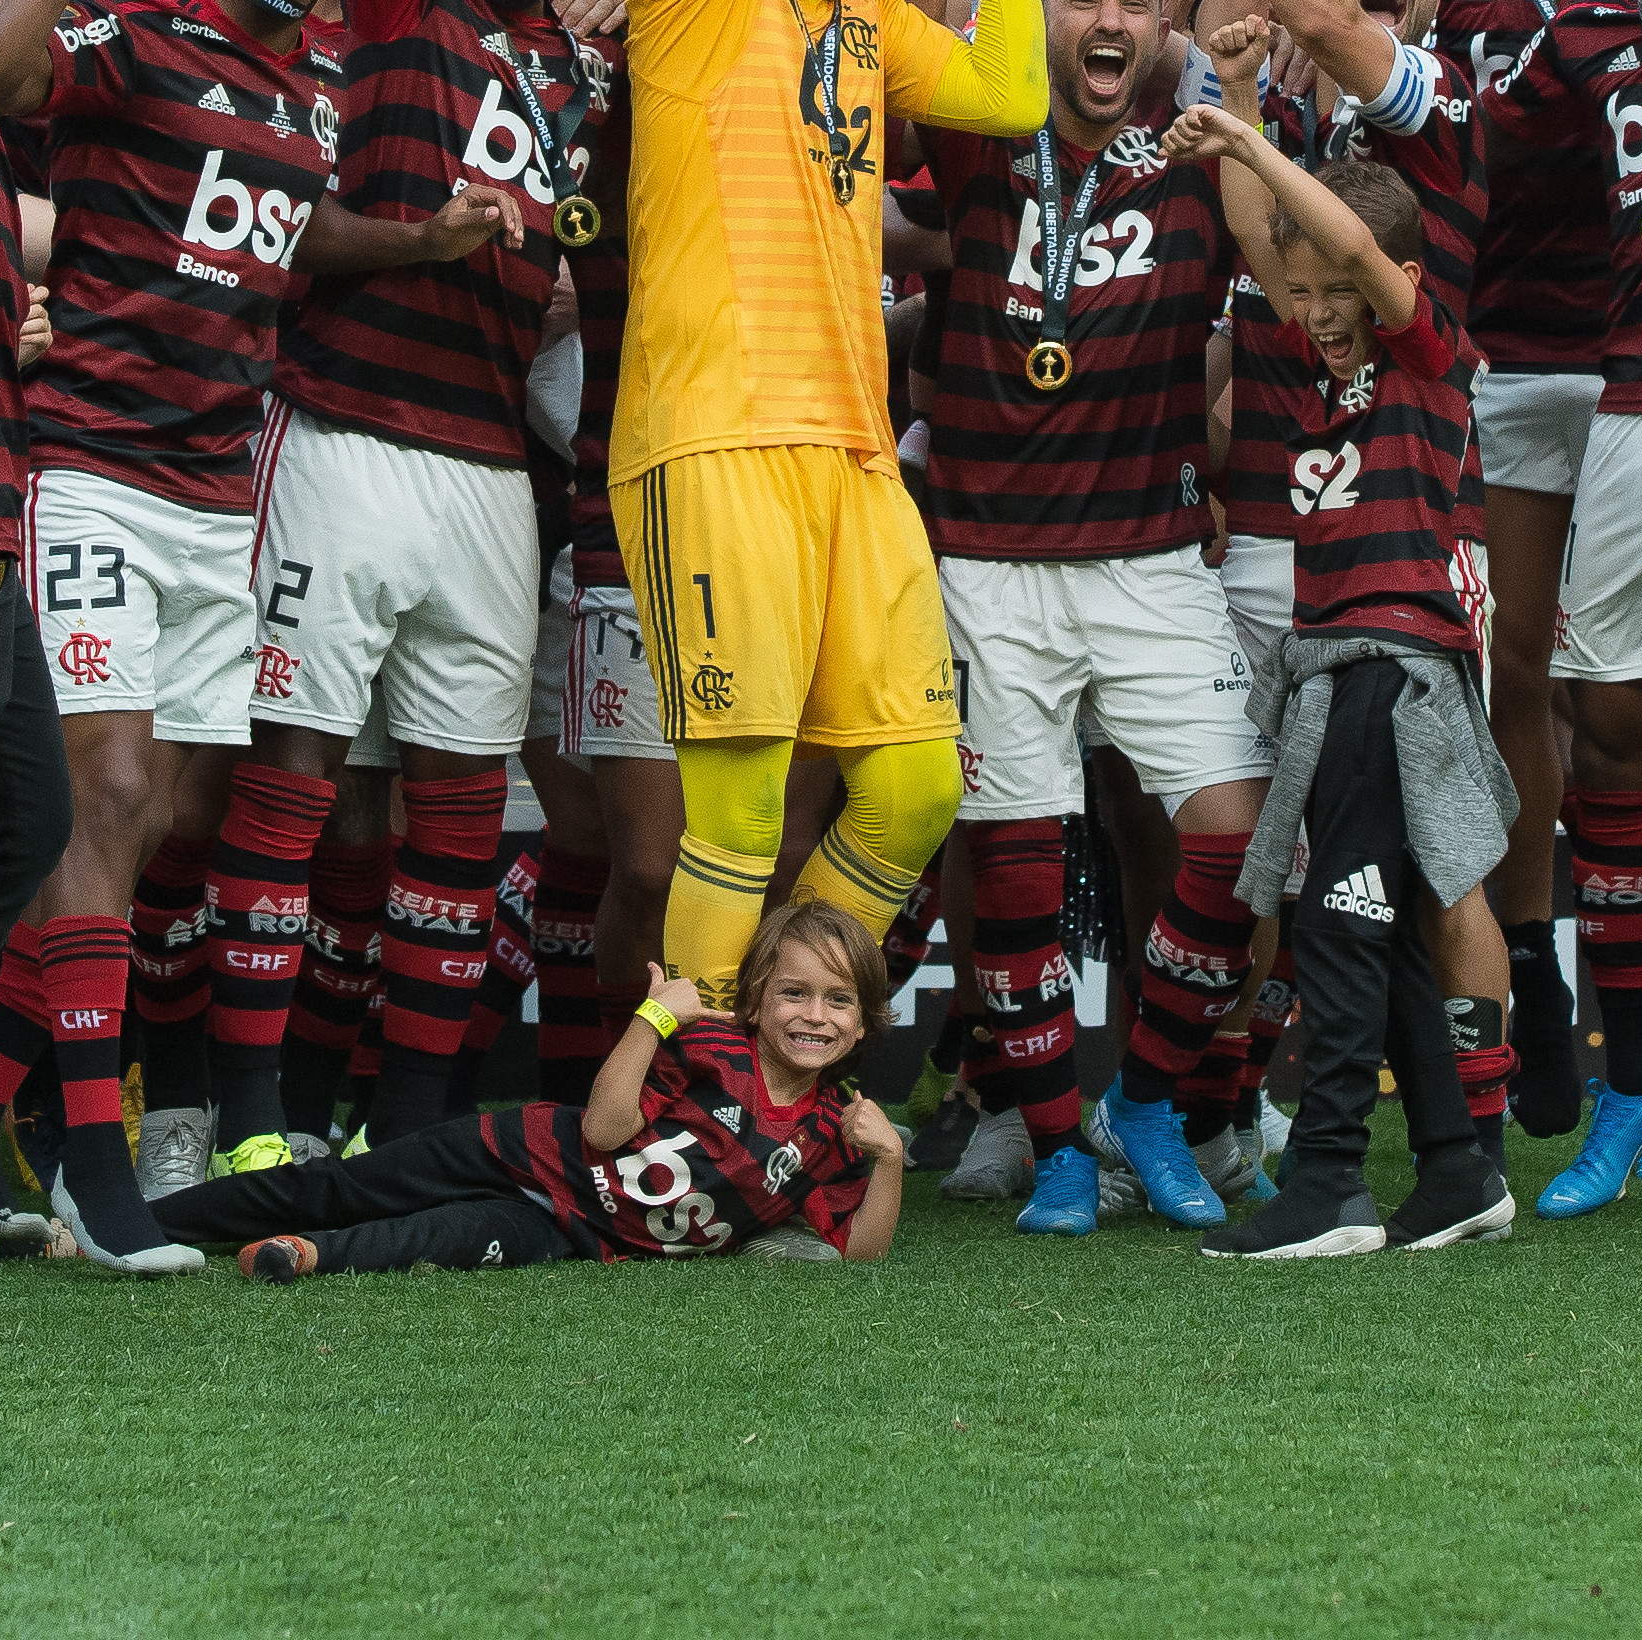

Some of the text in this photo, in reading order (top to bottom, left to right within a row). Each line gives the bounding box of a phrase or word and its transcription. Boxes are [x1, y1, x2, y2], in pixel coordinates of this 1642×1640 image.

[513, 64, 554, 151] LIBERTADORES
[1431, 93, 1472, 123] ser
[1037, 129, 1055, 190] CONMEBOL
[1073, 164, 1098, 219] LIBERTA
[183, 150, 313, 271] bs2
[176, 253, 240, 288] Banco
[1053, 231, 1079, 301] CONMEBOL
[1006, 296, 1045, 322] Ban
[47, 545, 127, 611] 23
[692, 573, 717, 639] 1
[924, 686, 956, 703] Bene
[1212, 676, 1252, 693] Bene
[249, 894, 308, 916] AZEI
[386, 902, 481, 936] OYAL
[390, 884, 479, 920] ZEITE
[1322, 892, 1396, 924] adidas
[248, 913, 308, 933] ROY
[226, 950, 290, 972] CRF
[1145, 942, 1239, 988] OYAL
[1151, 924, 1229, 972] ZEITE
[59, 1009, 109, 1030] CRF
[1004, 1026, 1061, 1059] CRF
[712, 1107, 742, 1135] adidas
